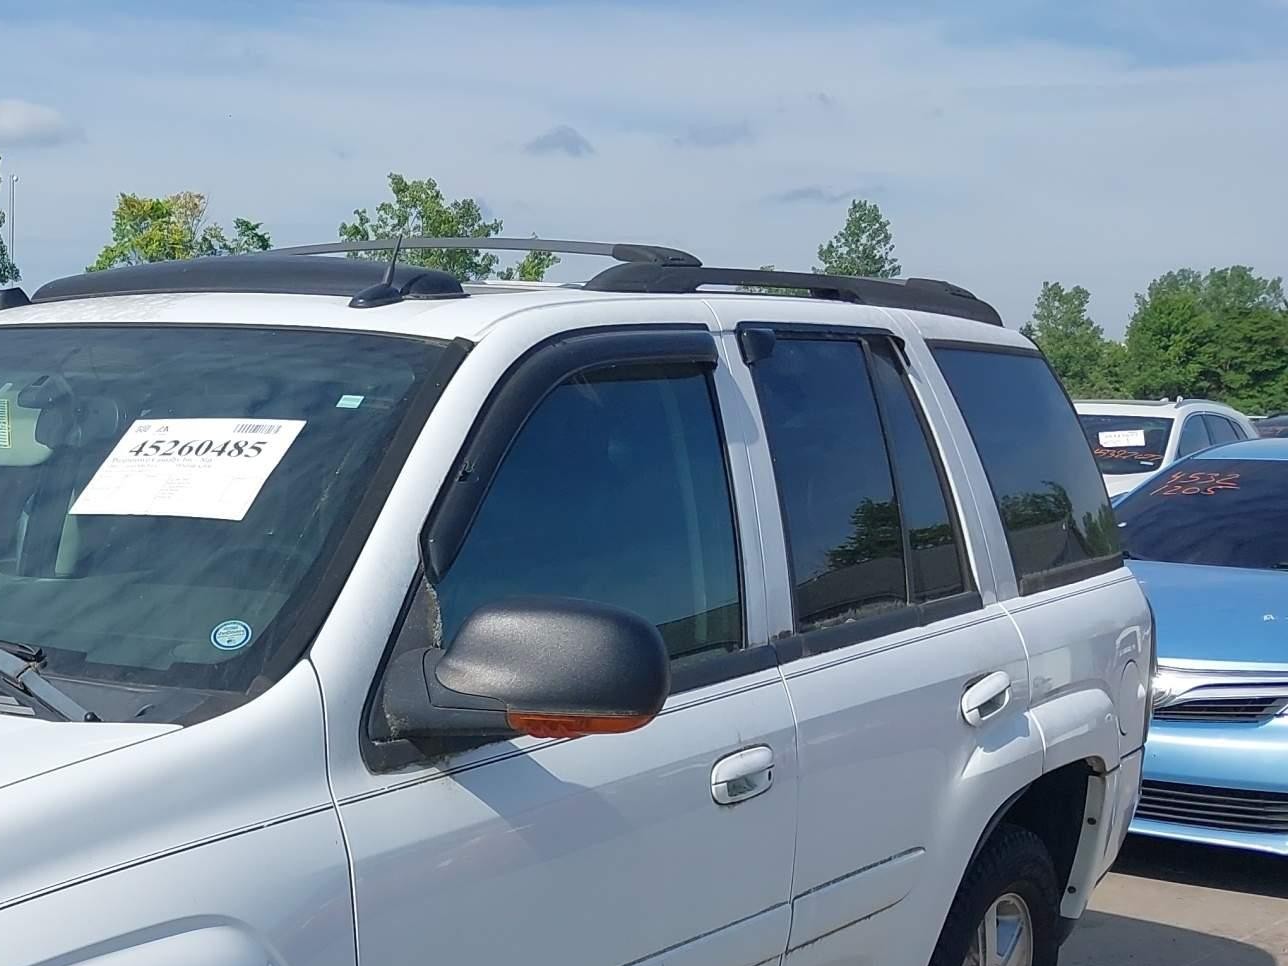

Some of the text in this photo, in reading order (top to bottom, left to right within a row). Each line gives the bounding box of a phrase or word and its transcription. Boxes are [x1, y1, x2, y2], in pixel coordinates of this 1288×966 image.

[129, 439, 267, 458] 45260485
[1167, 471, 1241, 485] 4532
[1149, 485, 1241, 496] 1205
